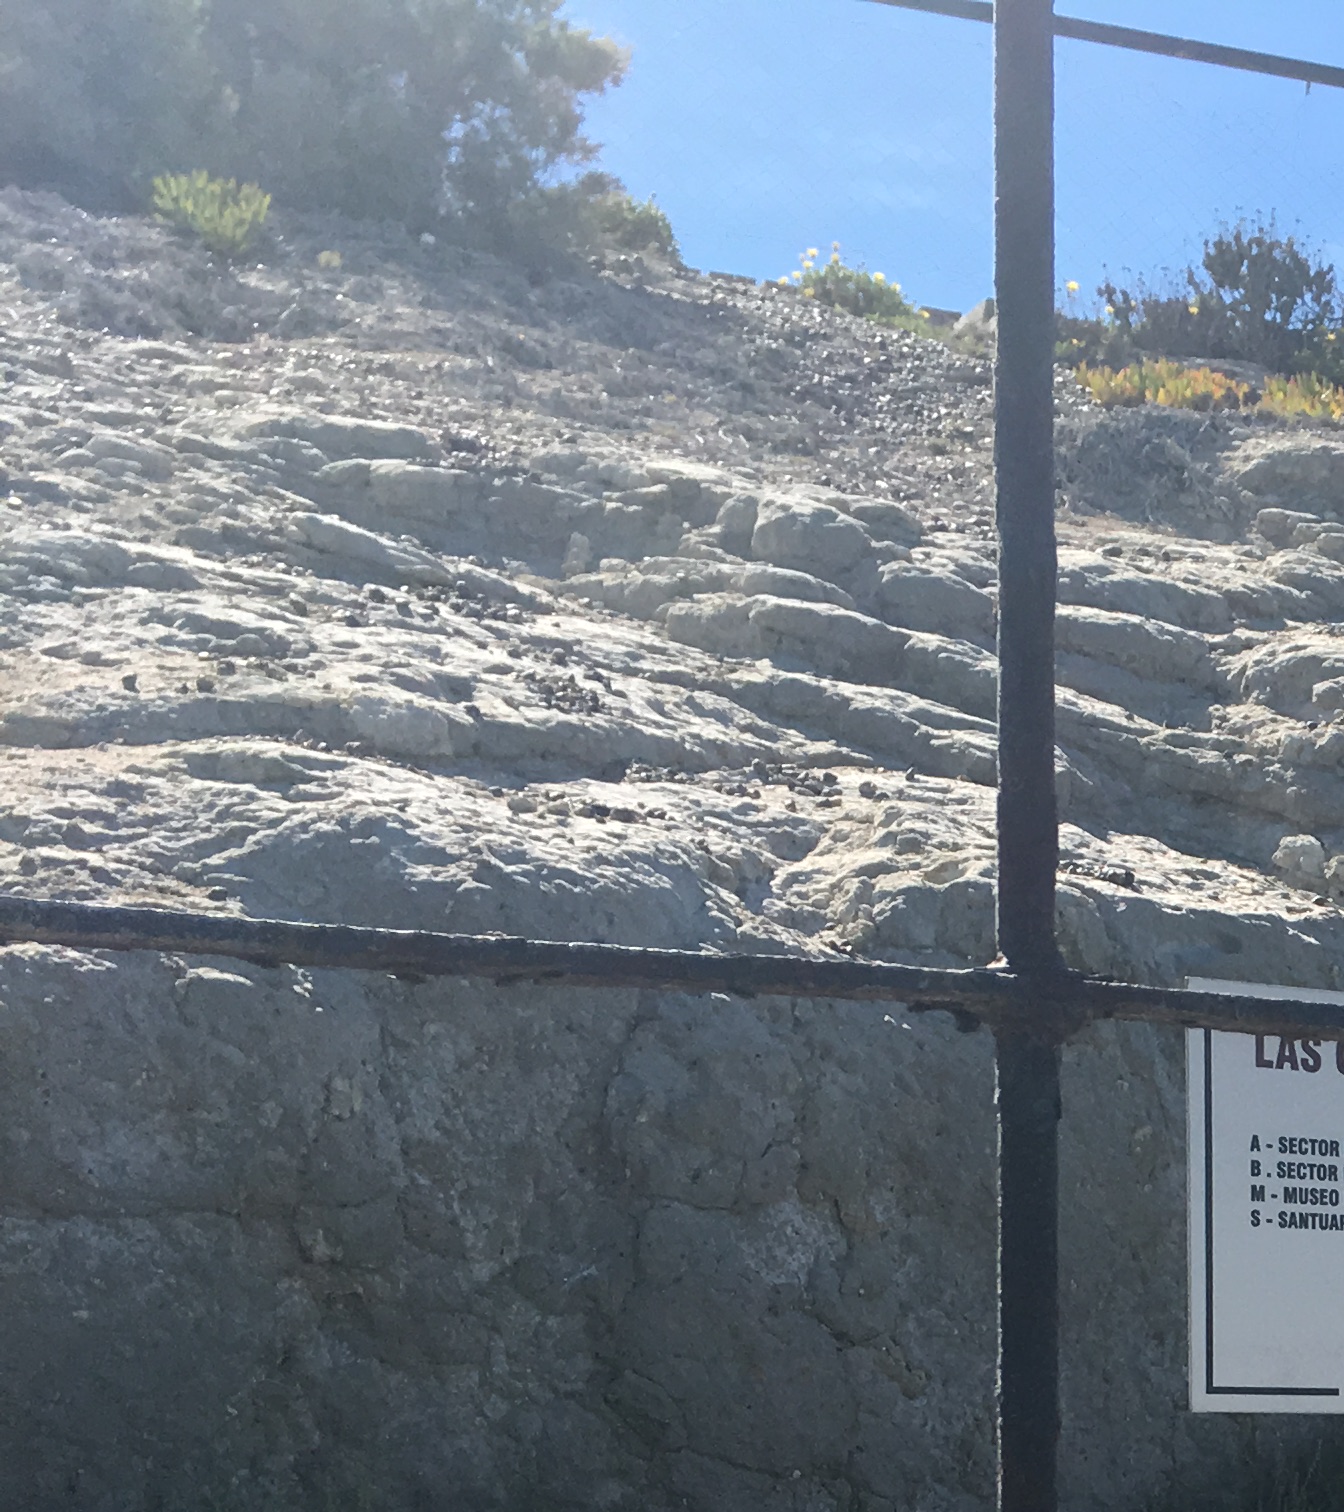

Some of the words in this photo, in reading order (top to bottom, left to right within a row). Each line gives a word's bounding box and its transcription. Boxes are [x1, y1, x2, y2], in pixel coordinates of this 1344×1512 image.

[1255, 1035, 1322, 1072] LAS
[1249, 1134, 1261, 1152] A
[1278, 1136, 1340, 1158] SECTOR
[1250, 1159, 1262, 1177] B
[1276, 1160, 1339, 1182] SECTOR
[1250, 1184, 1266, 1203] M
[1283, 1186, 1340, 1207] MUSEO
[1250, 1208, 1261, 1228] S
